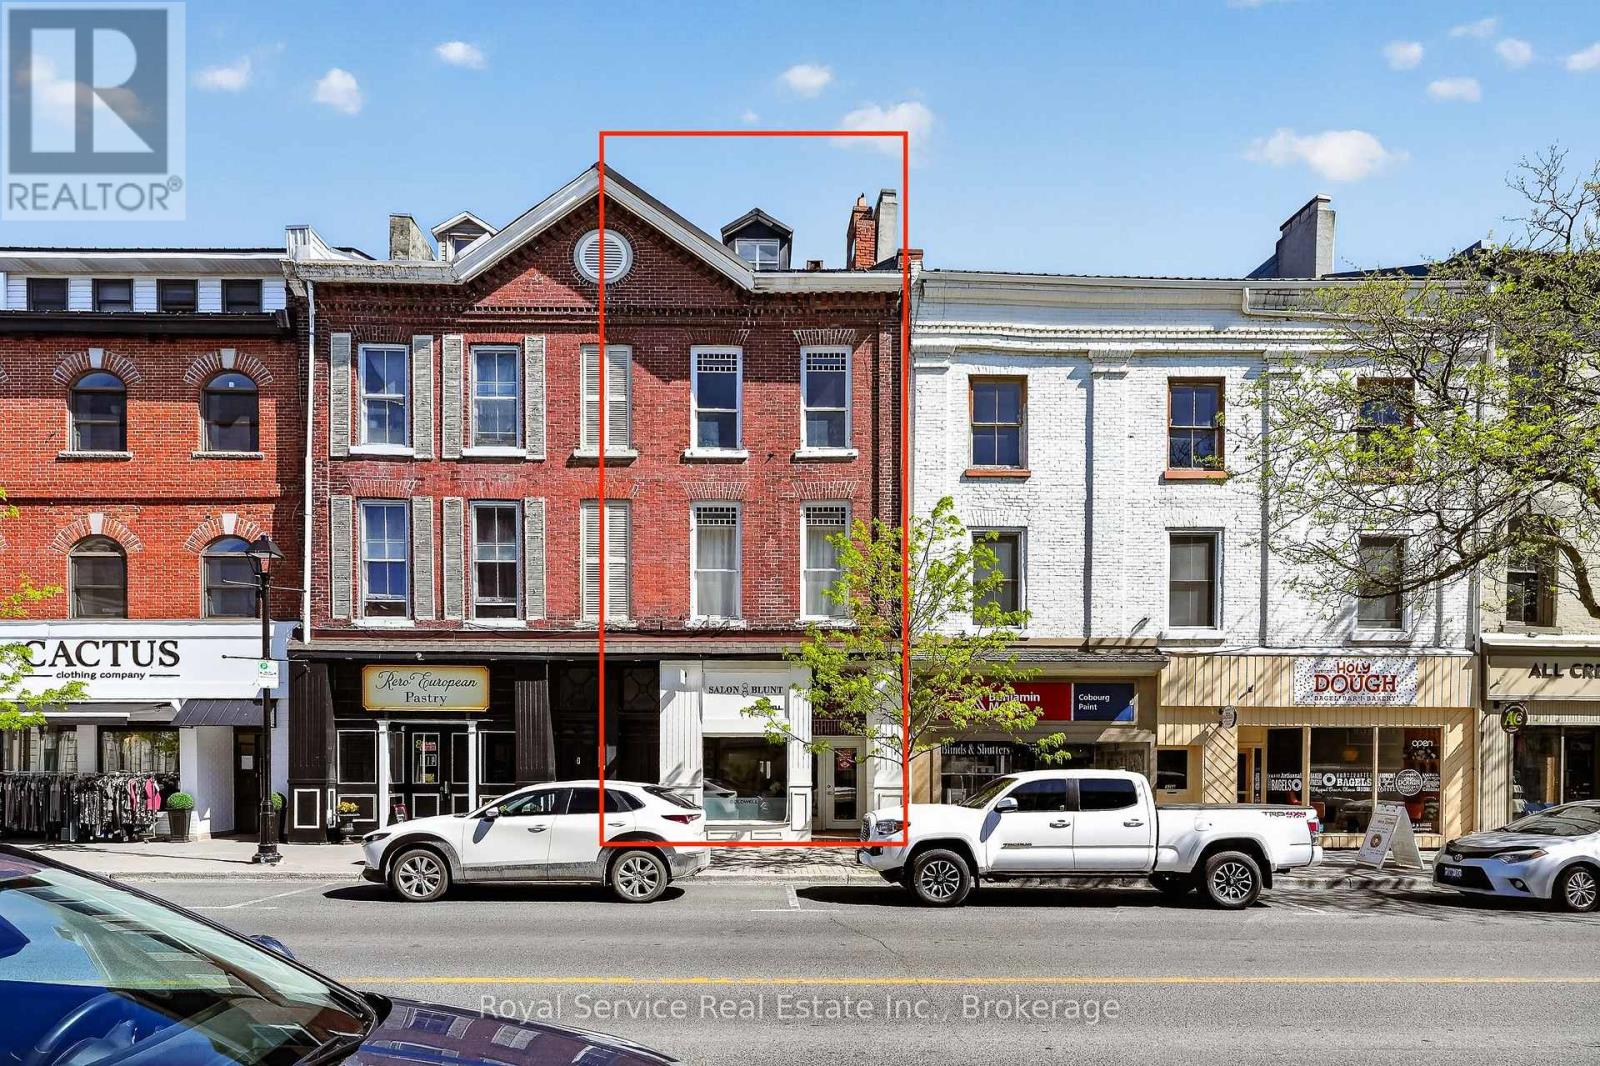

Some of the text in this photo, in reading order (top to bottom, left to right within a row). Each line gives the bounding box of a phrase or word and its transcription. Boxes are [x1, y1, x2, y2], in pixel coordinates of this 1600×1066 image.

[23, 640, 181, 667] CACTUS
[1336, 661, 1371, 674] HOLY
[1528, 662, 1564, 679] ALL
[56, 671, 146, 680] clothing company
[410, 671, 479, 692] European
[708, 686, 783, 694] SALON BLUNT
[1313, 674, 1398, 694] DOUGH
[405, 691, 448, 706] Pastry
[1078, 693, 1110, 703] Cobourg
[1078, 703, 1098, 711] Paint
[942, 743, 1011, 755] Blinds & Shutters
[1411, 740, 1434, 748] open
[1271, 779, 1292, 791] BAGELS
[1336, 778, 1373, 787] BAGELS
